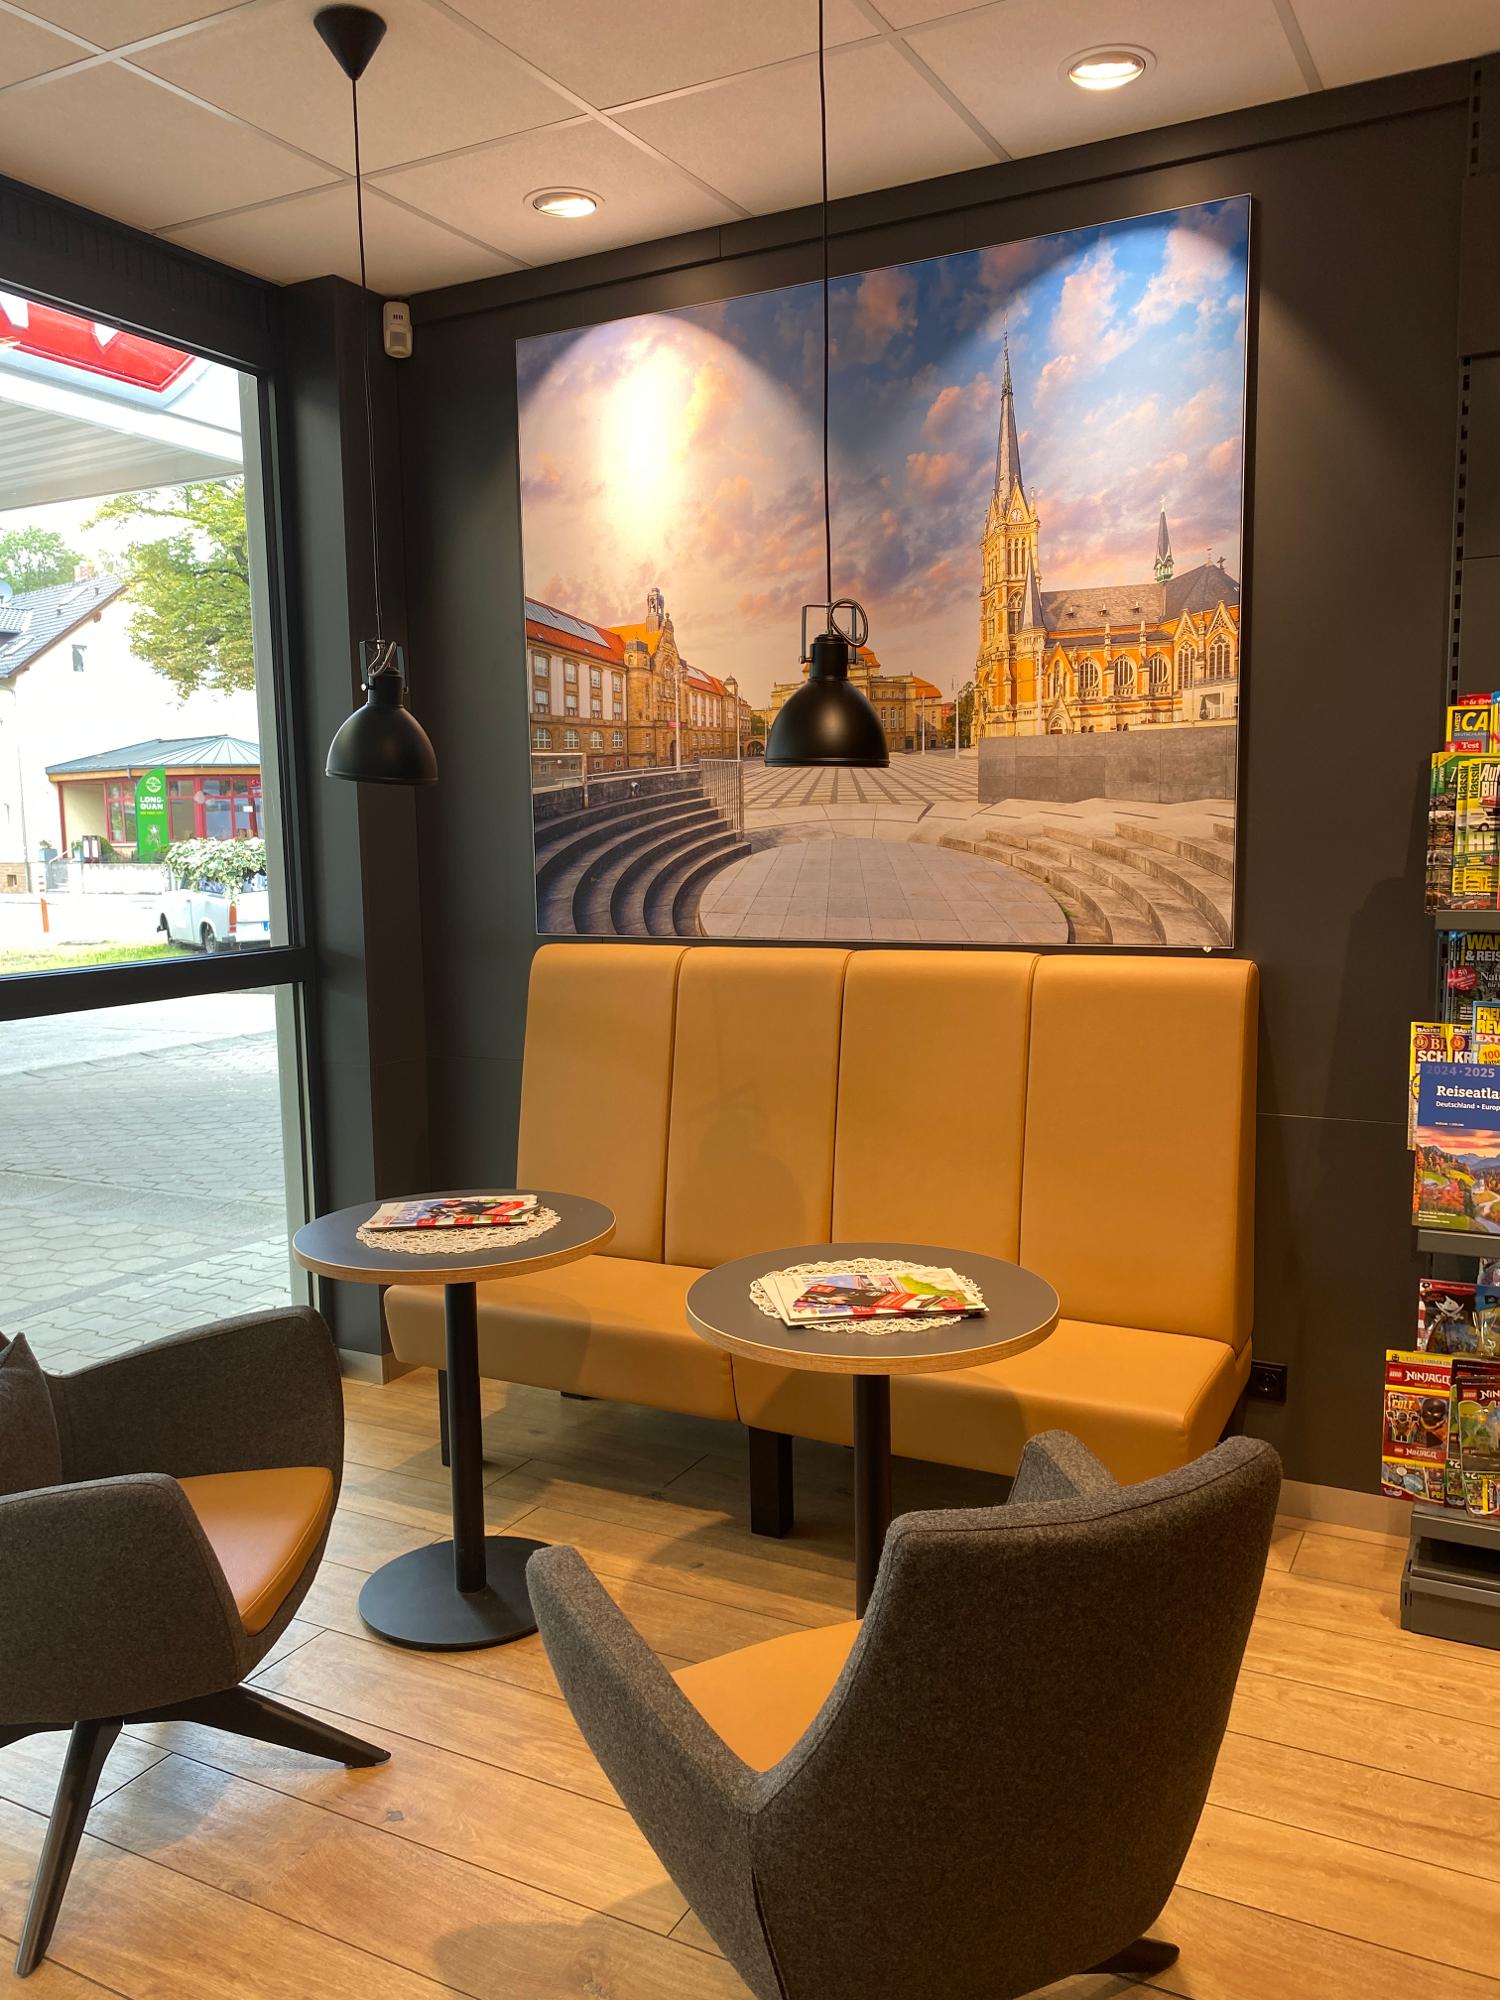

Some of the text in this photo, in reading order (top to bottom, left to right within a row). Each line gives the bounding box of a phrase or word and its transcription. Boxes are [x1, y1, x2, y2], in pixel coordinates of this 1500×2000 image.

[1461, 741, 1480, 749] Test
[1465, 1067, 1495, 1077] 2025
[1436, 1101, 1475, 1109] Deutschland
[1404, 1370, 1451, 1386] NINJAGO
